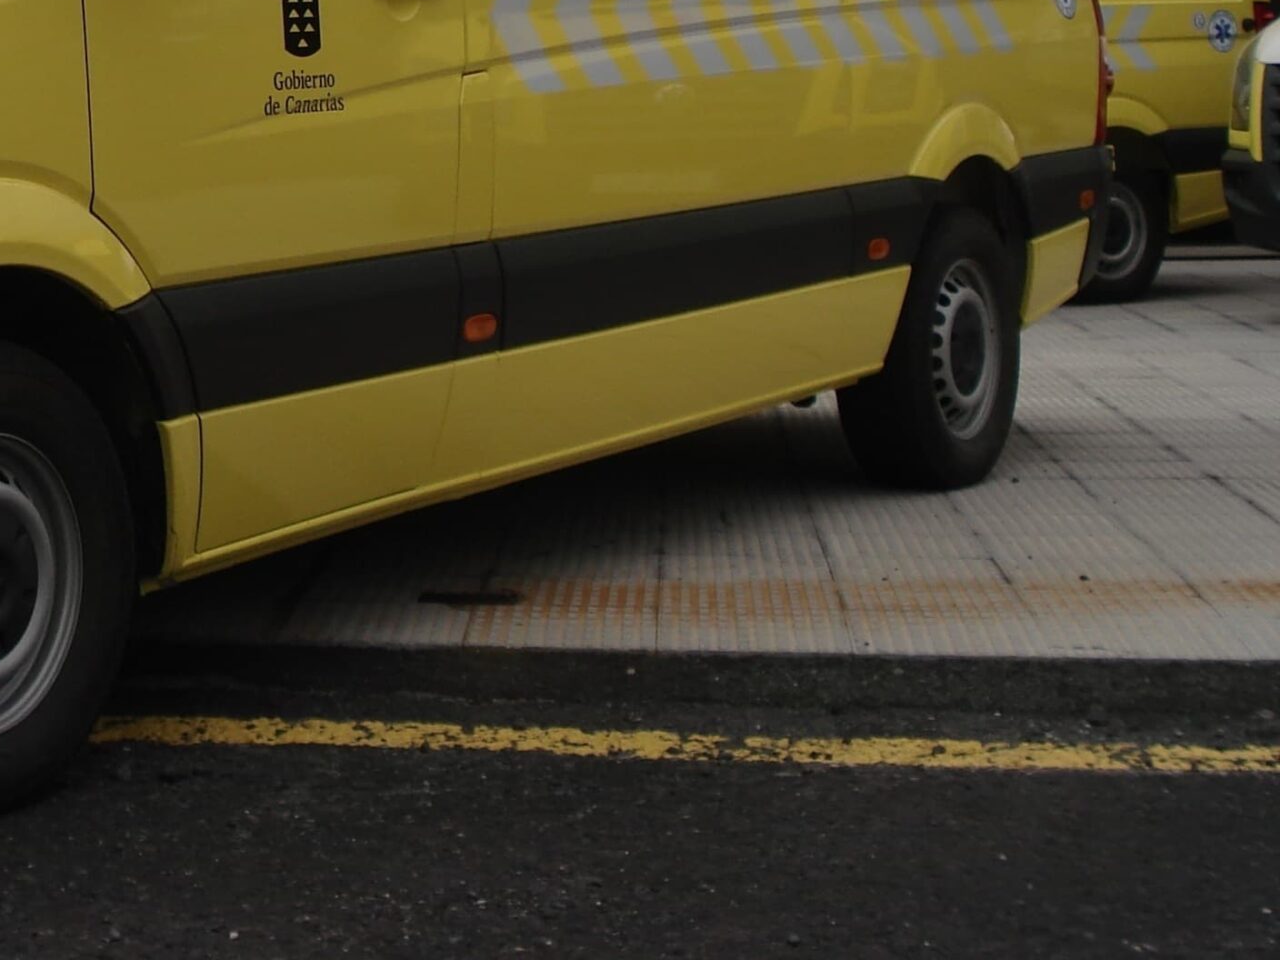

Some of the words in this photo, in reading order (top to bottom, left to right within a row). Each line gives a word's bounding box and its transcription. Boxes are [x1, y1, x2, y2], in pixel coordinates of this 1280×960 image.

[273, 69, 336, 91] Gobierno
[264, 95, 281, 117] de
[285, 92, 345, 115] Canarias
